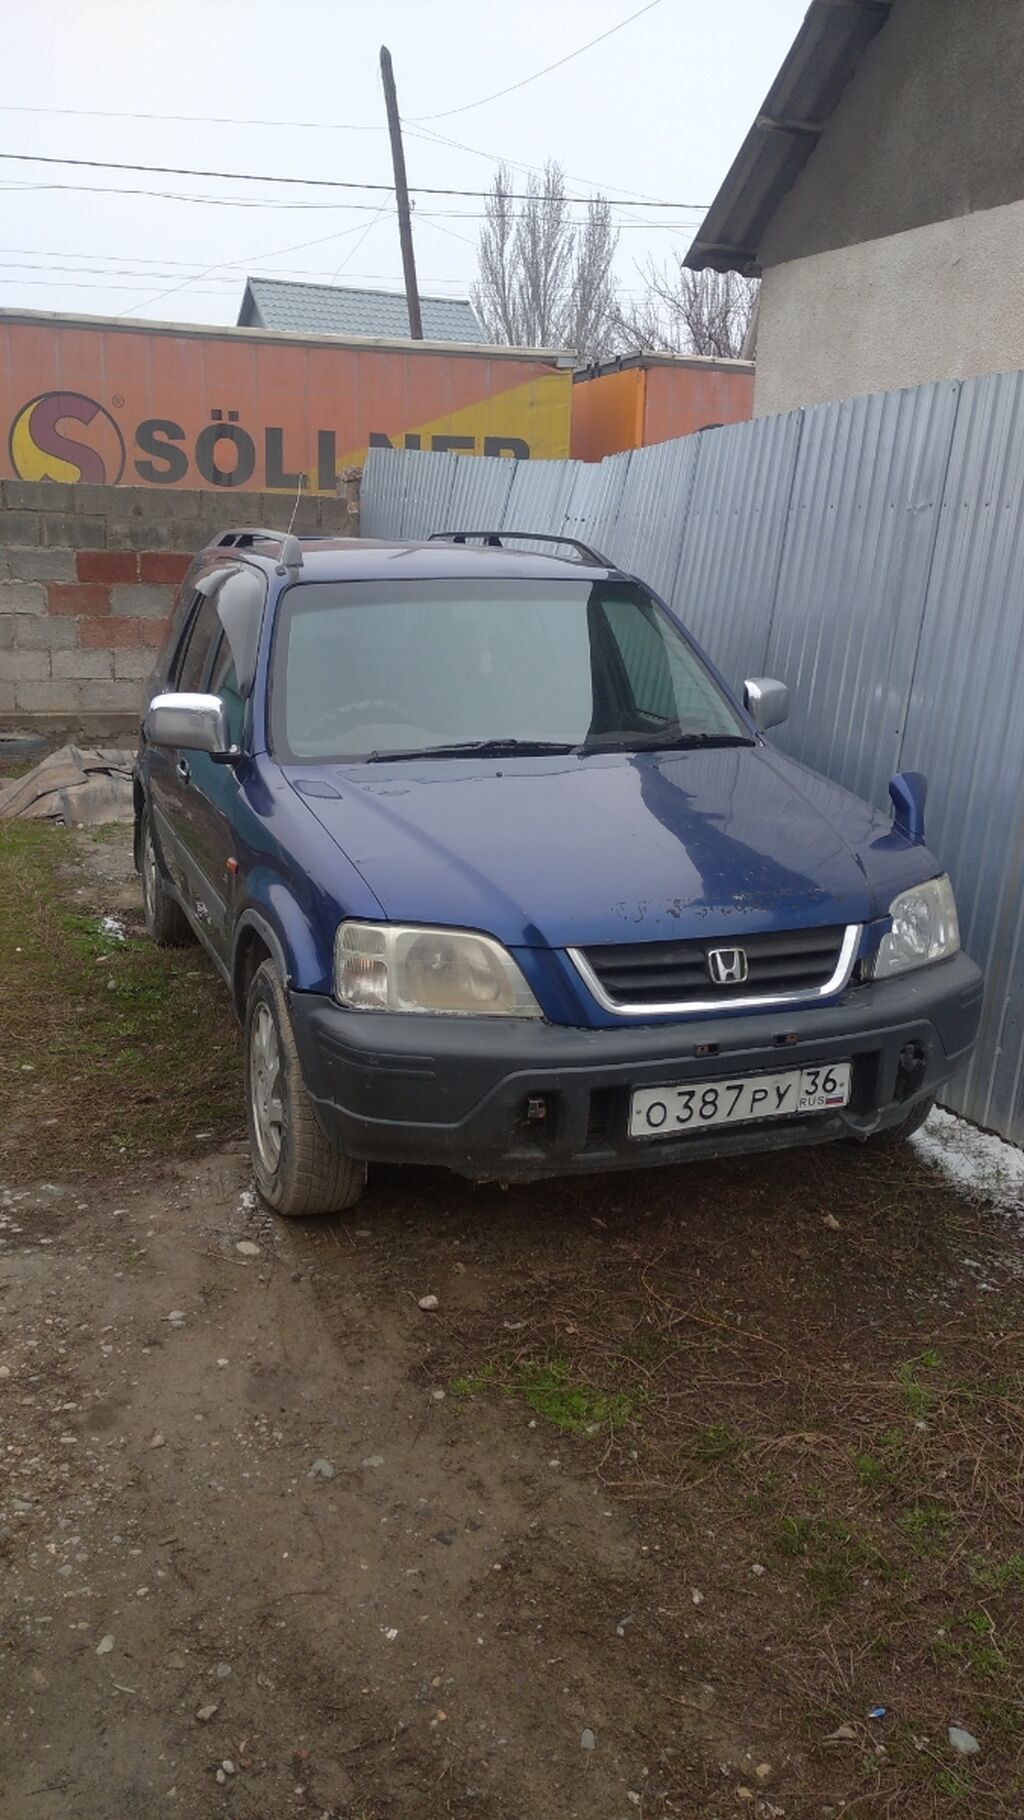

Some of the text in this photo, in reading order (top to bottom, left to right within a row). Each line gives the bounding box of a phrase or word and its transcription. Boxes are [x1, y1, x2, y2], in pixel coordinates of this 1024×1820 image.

[134, 408, 530, 491] SÖLL
[804, 1067, 838, 1096] 36
[799, 1096, 825, 1108] RUS
